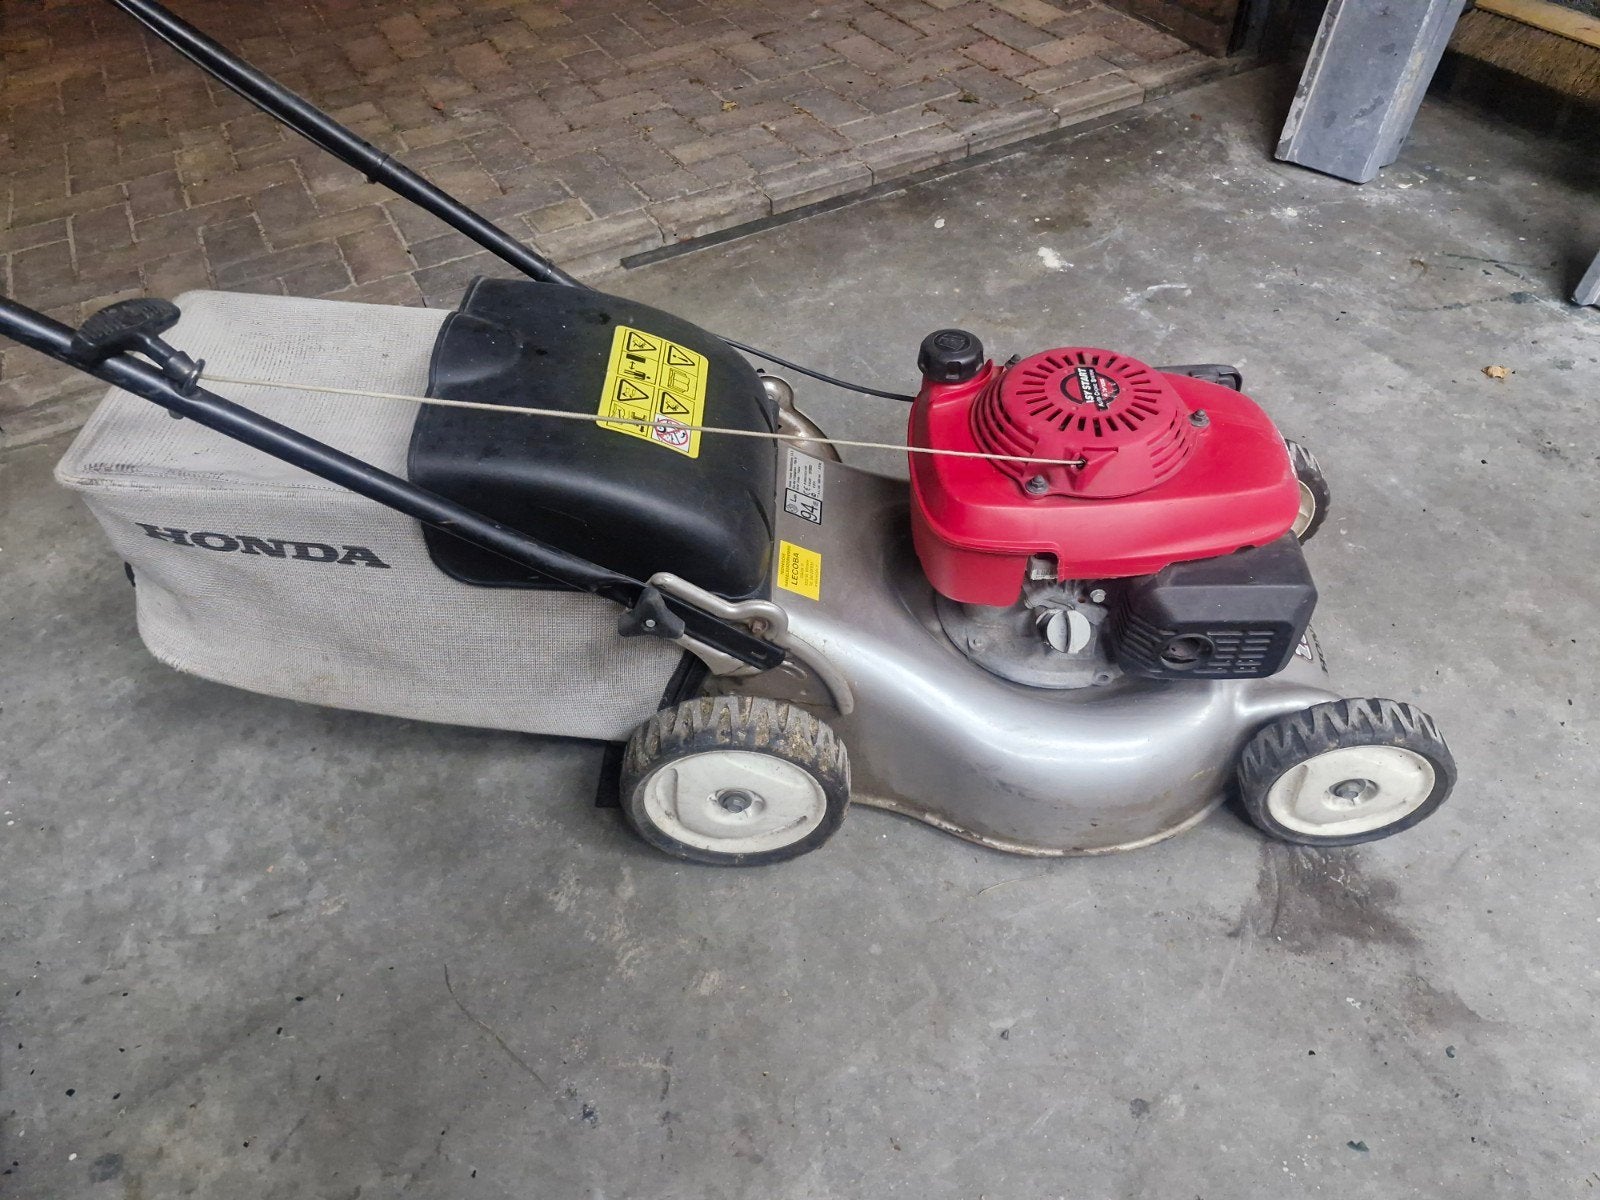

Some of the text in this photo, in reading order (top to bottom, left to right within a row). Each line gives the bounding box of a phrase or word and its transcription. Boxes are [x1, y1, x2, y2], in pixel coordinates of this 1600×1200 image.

[1077, 368, 1091, 390] START
[800, 503, 818, 522] 94
[134, 522, 392, 569] HONDA
[791, 552, 800, 586] LECOBA
